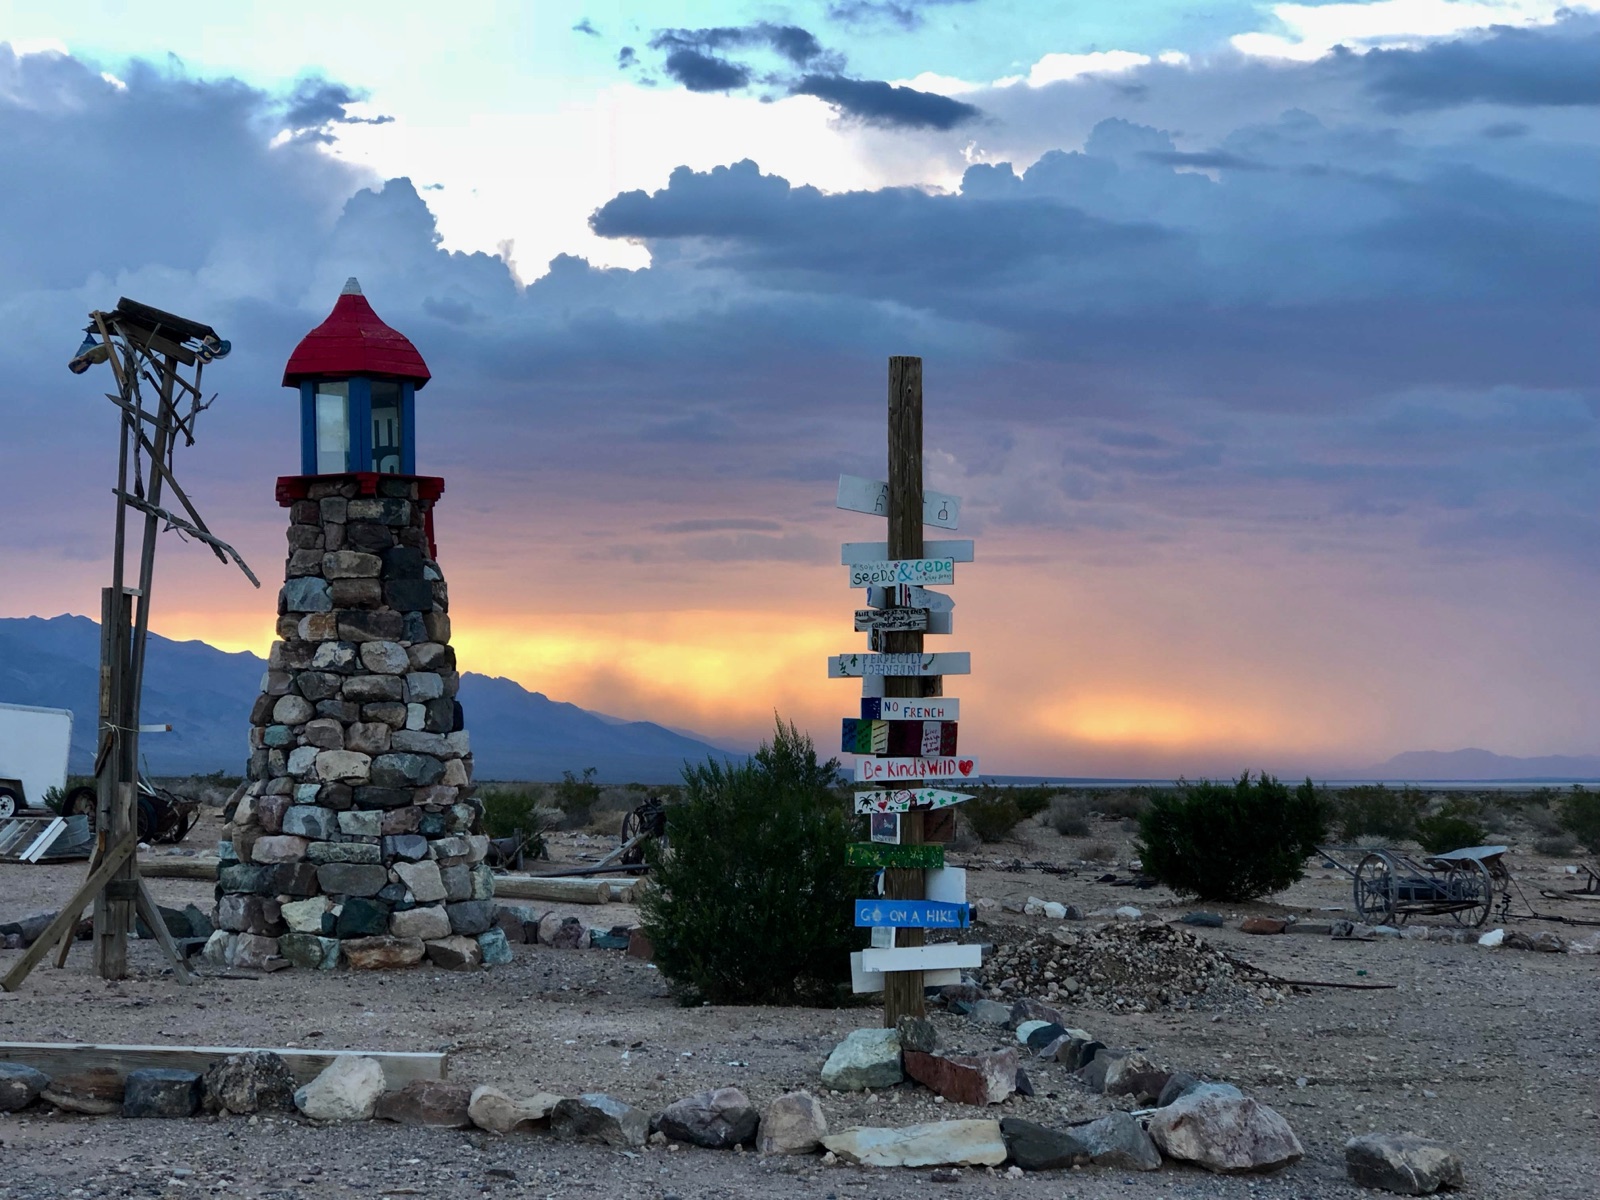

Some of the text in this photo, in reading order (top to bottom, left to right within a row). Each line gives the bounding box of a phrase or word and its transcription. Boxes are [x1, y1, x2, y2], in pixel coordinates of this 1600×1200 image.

[897, 562, 913, 582] &
[862, 653, 923, 664] PERFECTLY
[861, 664, 921, 675] IMPERFECT
[884, 701, 945, 718] NO FRENCH
[863, 760, 882, 780] Be
[887, 758, 917, 778] Kind
[889, 909, 907, 921] ON
[910, 909, 920, 922] A
[926, 909, 956, 923] HIKE
